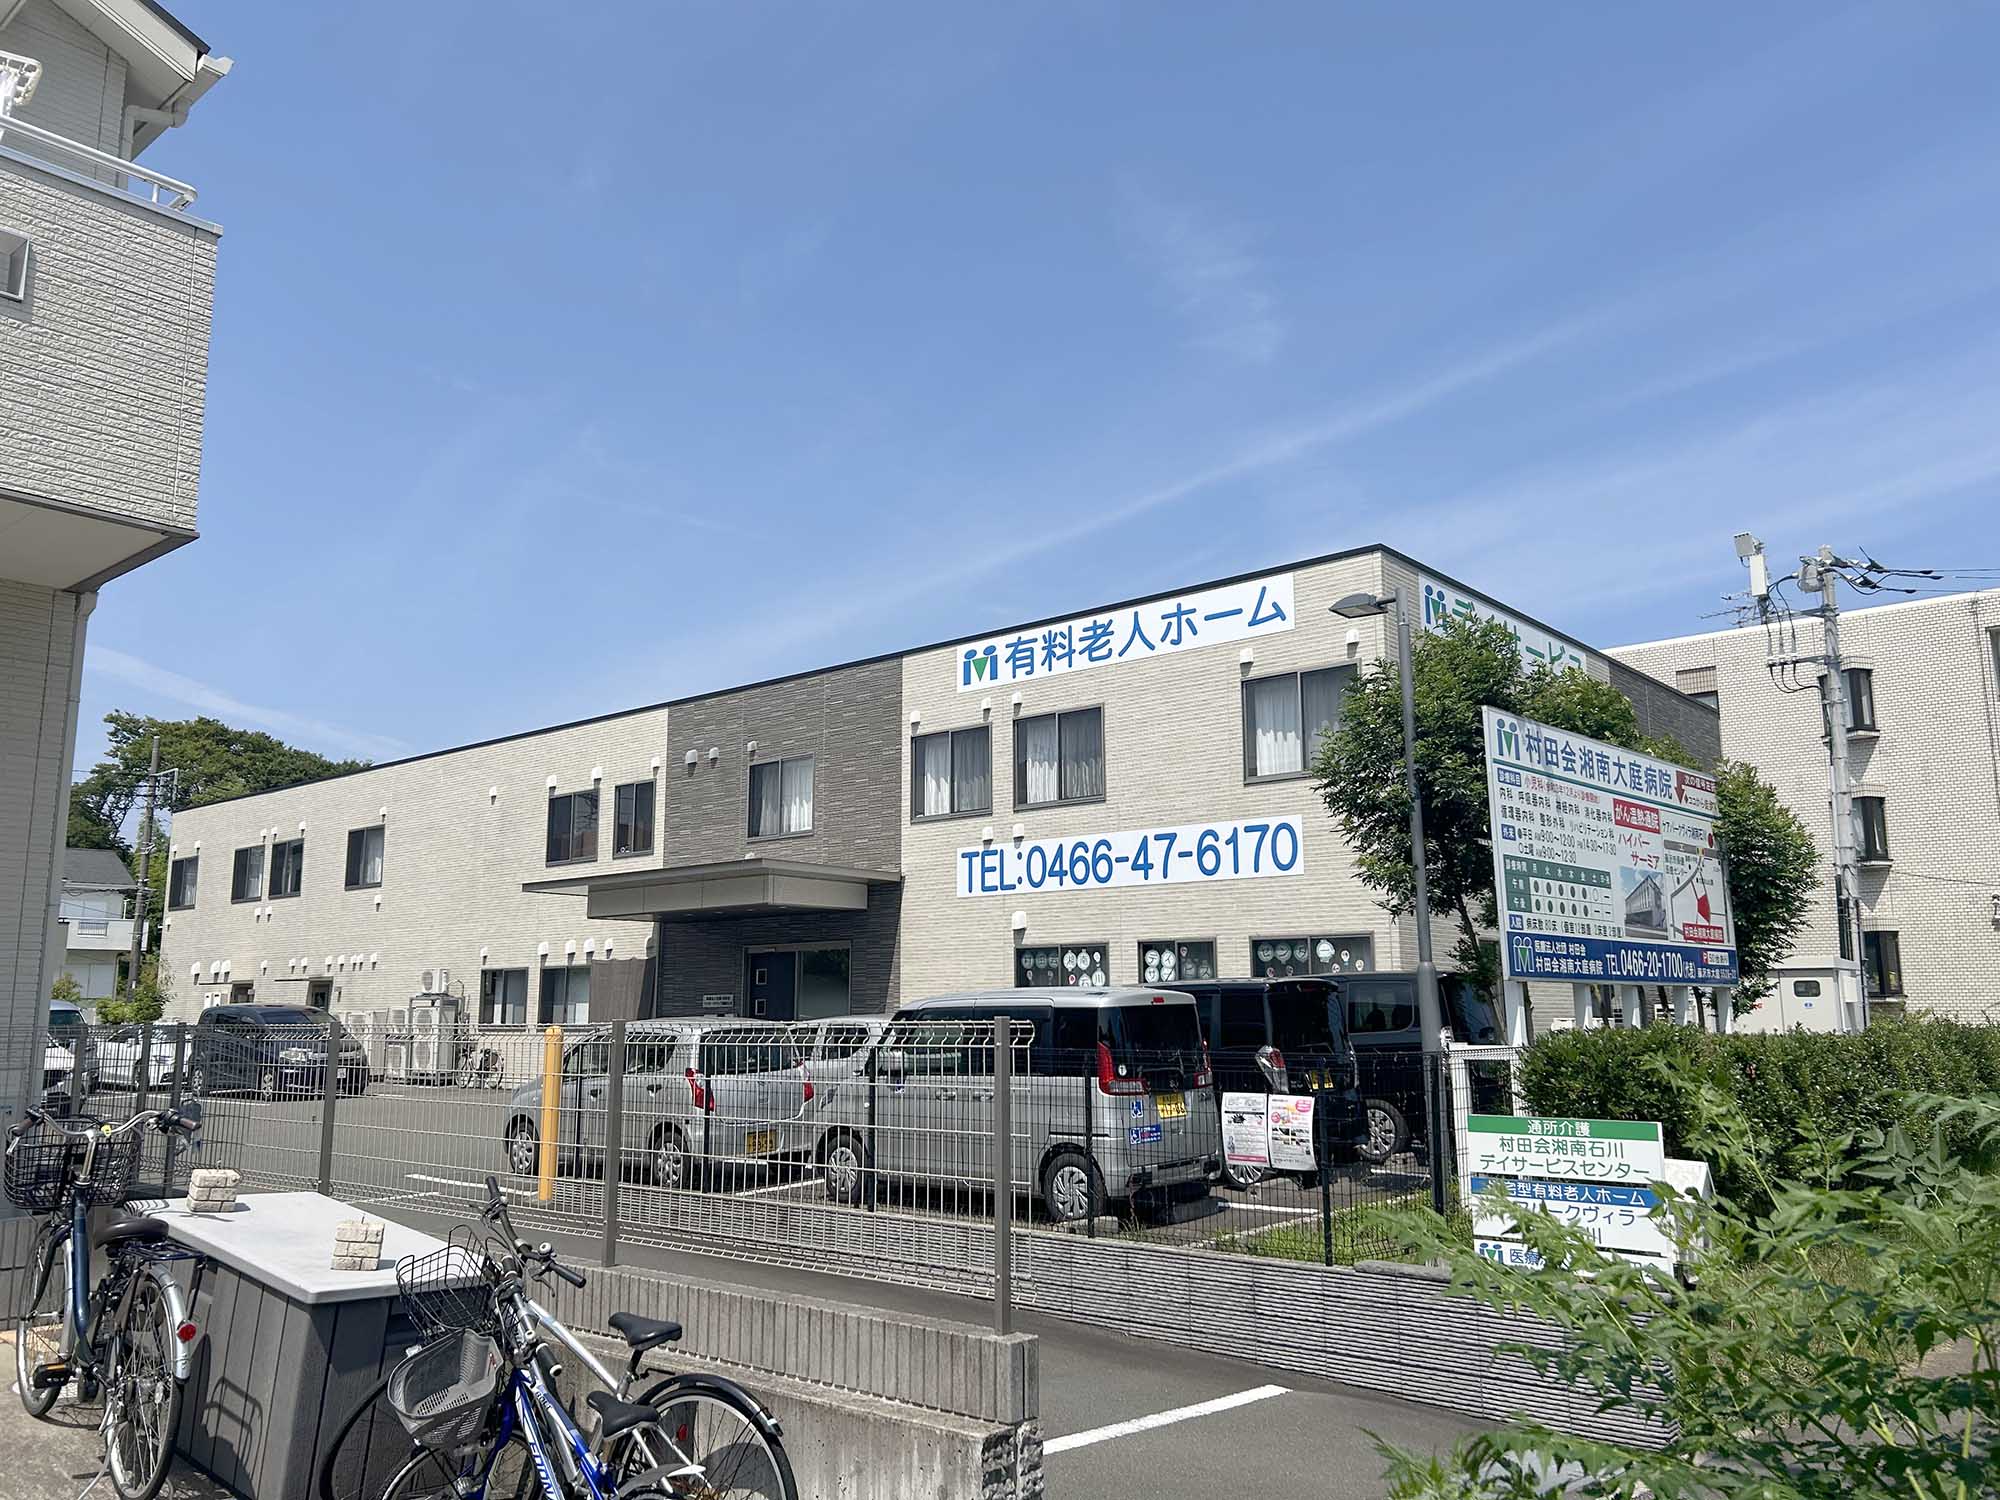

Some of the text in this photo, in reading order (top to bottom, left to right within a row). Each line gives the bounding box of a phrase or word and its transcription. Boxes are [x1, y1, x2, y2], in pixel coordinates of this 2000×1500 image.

[1005, 585, 1286, 679] 有料老人ホーム
[1524, 727, 1672, 799] 村田会湘南大庭病院
[961, 821, 1299, 893] TEL:0466-47-6170
[1630, 851, 1660, 870] サーミア
[1568, 943, 1585, 954] 村田会
[1535, 956, 1603, 974] 村田会湘南大庭病院
[1606, 954, 1619, 974] TEL
[1619, 950, 1683, 978] 0466-20-1700
[1527, 1119, 1591, 1137] 通所介護
[1499, 1136, 1625, 1159] 村田会湘南石川
[1479, 1154, 1650, 1179] デイサービスセンター
[1490, 1180, 1646, 1206] 宅型有料老人ホーム
